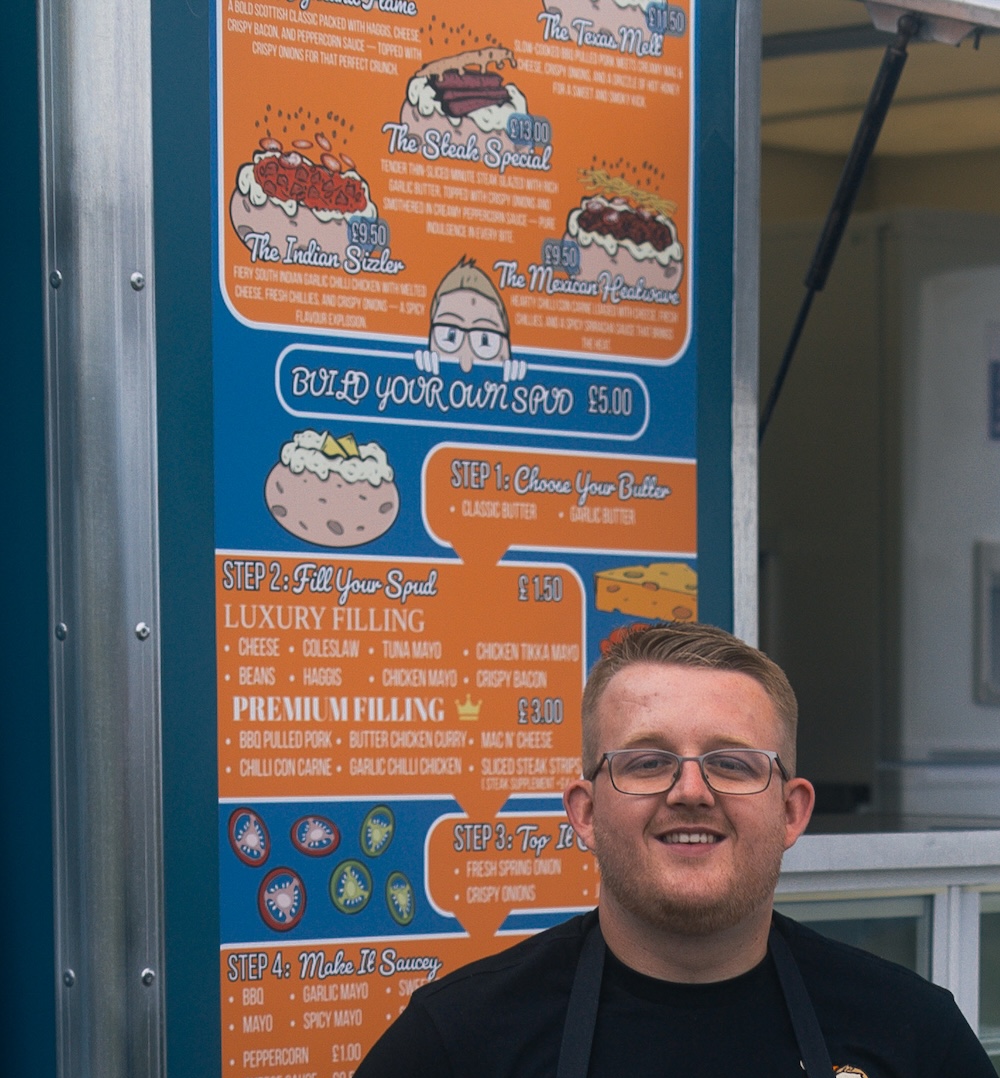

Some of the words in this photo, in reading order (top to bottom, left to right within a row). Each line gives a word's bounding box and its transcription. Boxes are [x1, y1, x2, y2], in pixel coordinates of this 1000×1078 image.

[228, 0, 233, 12] A
[234, 1, 253, 15] BOLD
[255, 4, 288, 20] SCOTTISH
[289, 9, 318, 25] CLASSIC
[319, 14, 346, 30] PACKED
[348, 19, 365, 33] WITH
[648, 7, 684, 32] £11.50
[228, 18, 252, 33] CRISPY
[282, 27, 296, 40] AND
[297, 29, 342, 48] PEPPERCORN
[343, 36, 364, 52] SAUCE
[378, 42, 403, 58] TOPPED
[404, 47, 422, 60] WITH
[538, 12, 569, 40] The
[572, 19, 617, 46] Texas
[619, 27, 662, 56] Melt
[252, 41, 277, 56] CRISPY
[279, 45, 304, 61] ONIONS
[306, 50, 318, 62] FOR
[320, 51, 338, 66] THAT
[339, 54, 368, 70] PERFECT
[510, 118, 549, 142] £13.00
[382, 123, 417, 154] The
[422, 129, 479, 160] Steak
[483, 138, 552, 174] Special
[352, 222, 386, 246] £9.50
[245, 232, 279, 262] The
[283, 236, 339, 268] Indian
[344, 245, 405, 275] Sizzler
[545, 244, 577, 267] £9.50
[234, 266, 252, 279] FIERY
[255, 267, 278, 281] SOUTH
[280, 270, 302, 284] INDIAN
[304, 272, 328, 287] GARLIC
[351, 277, 380, 292] CHICKEN
[494, 260, 526, 289] The
[528, 265, 598, 296] Mexican
[599, 271, 679, 304] Heatwave
[266, 288, 288, 302] FRESH
[323, 294, 336, 306] AND
[338, 294, 360, 309] CRISPY
[292, 367, 368, 405] BUILD
[376, 375, 448, 412] YOUR
[450, 379, 508, 409] OWN
[512, 385, 573, 415] SPUD
[588, 386, 632, 415] £5.00
[451, 460, 490, 488] STEP
[495, 463, 509, 490] 1:
[514, 465, 572, 494] Choose
[576, 471, 616, 506] Your
[618, 472, 671, 500] Butter
[462, 500, 499, 518] CLASSIC
[502, 502, 537, 520] BUTTER
[570, 506, 600, 523] GARLIC
[602, 507, 636, 525] BUTTER
[223, 561, 265, 590] STEP
[270, 562, 289, 590] 2:
[292, 563, 333, 593] Fill
[336, 567, 382, 605] Your
[384, 569, 437, 604] Spud
[224, 604, 326, 630] LUXURY
[333, 607, 425, 633] FILLING
[239, 638, 280, 657] CHEESE
[303, 640, 360, 658] COLESLAW
[383, 640, 411, 659] TUNA
[412, 641, 442, 660] MAYO
[476, 642, 518, 660] CHICKEN
[520, 644, 550, 661] TIKKA
[552, 644, 579, 662] MAYO
[239, 667, 275, 686] BEANS
[303, 668, 342, 686] HAGGIS
[383, 669, 427, 687] CHICKEN
[428, 669, 458, 688] MAYO
[476, 670, 510, 688] CRISPY
[514, 670, 548, 688] BACON
[232, 696, 348, 721] PREMIUM
[354, 697, 444, 722] FILLING
[240, 730, 260, 749] BBQ
[263, 730, 301, 749] PULLED
[305, 731, 332, 749] PORK
[350, 730, 388, 748] BUTTER
[390, 730, 432, 749] CHICKEN
[434, 730, 467, 749] CURRY
[481, 731, 504, 749] MAC
[516, 731, 553, 749] CHEESE
[240, 758, 272, 777] CHILLI
[274, 758, 296, 777] CON
[298, 758, 332, 777] CARNE
[350, 758, 386, 776] GARLIC
[388, 758, 418, 776] CHILLI
[420, 758, 462, 776] CHICKEN
[481, 757, 515, 776] SLICED
[516, 757, 545, 776] STEAK
[550, 757, 583, 776] STRIPS
[454, 824, 492, 851] STEP
[496, 824, 512, 850] 3:
[516, 824, 551, 857] Top
[466, 860, 497, 878] FRESH
[500, 859, 532, 877] SPRING
[534, 858, 562, 875] ONION
[467, 886, 499, 904] CRISPY
[502, 884, 536, 902] ONIONS
[228, 953, 268, 981] STEP
[272, 952, 290, 978] 4:
[300, 950, 354, 979] Make
[357, 949, 377, 975] It
[379, 949, 442, 979] Saucey
[242, 988, 264, 1006] BBQ
[303, 984, 338, 1003] GARLIC
[340, 982, 368, 1000] MAYO
[243, 1014, 272, 1033] MAYO
[304, 1011, 331, 1029] SPICY
[334, 1009, 362, 1028] MAYO
[244, 1048, 309, 1068] PEPPERCORN
[332, 1043, 362, 1062] £1.00
